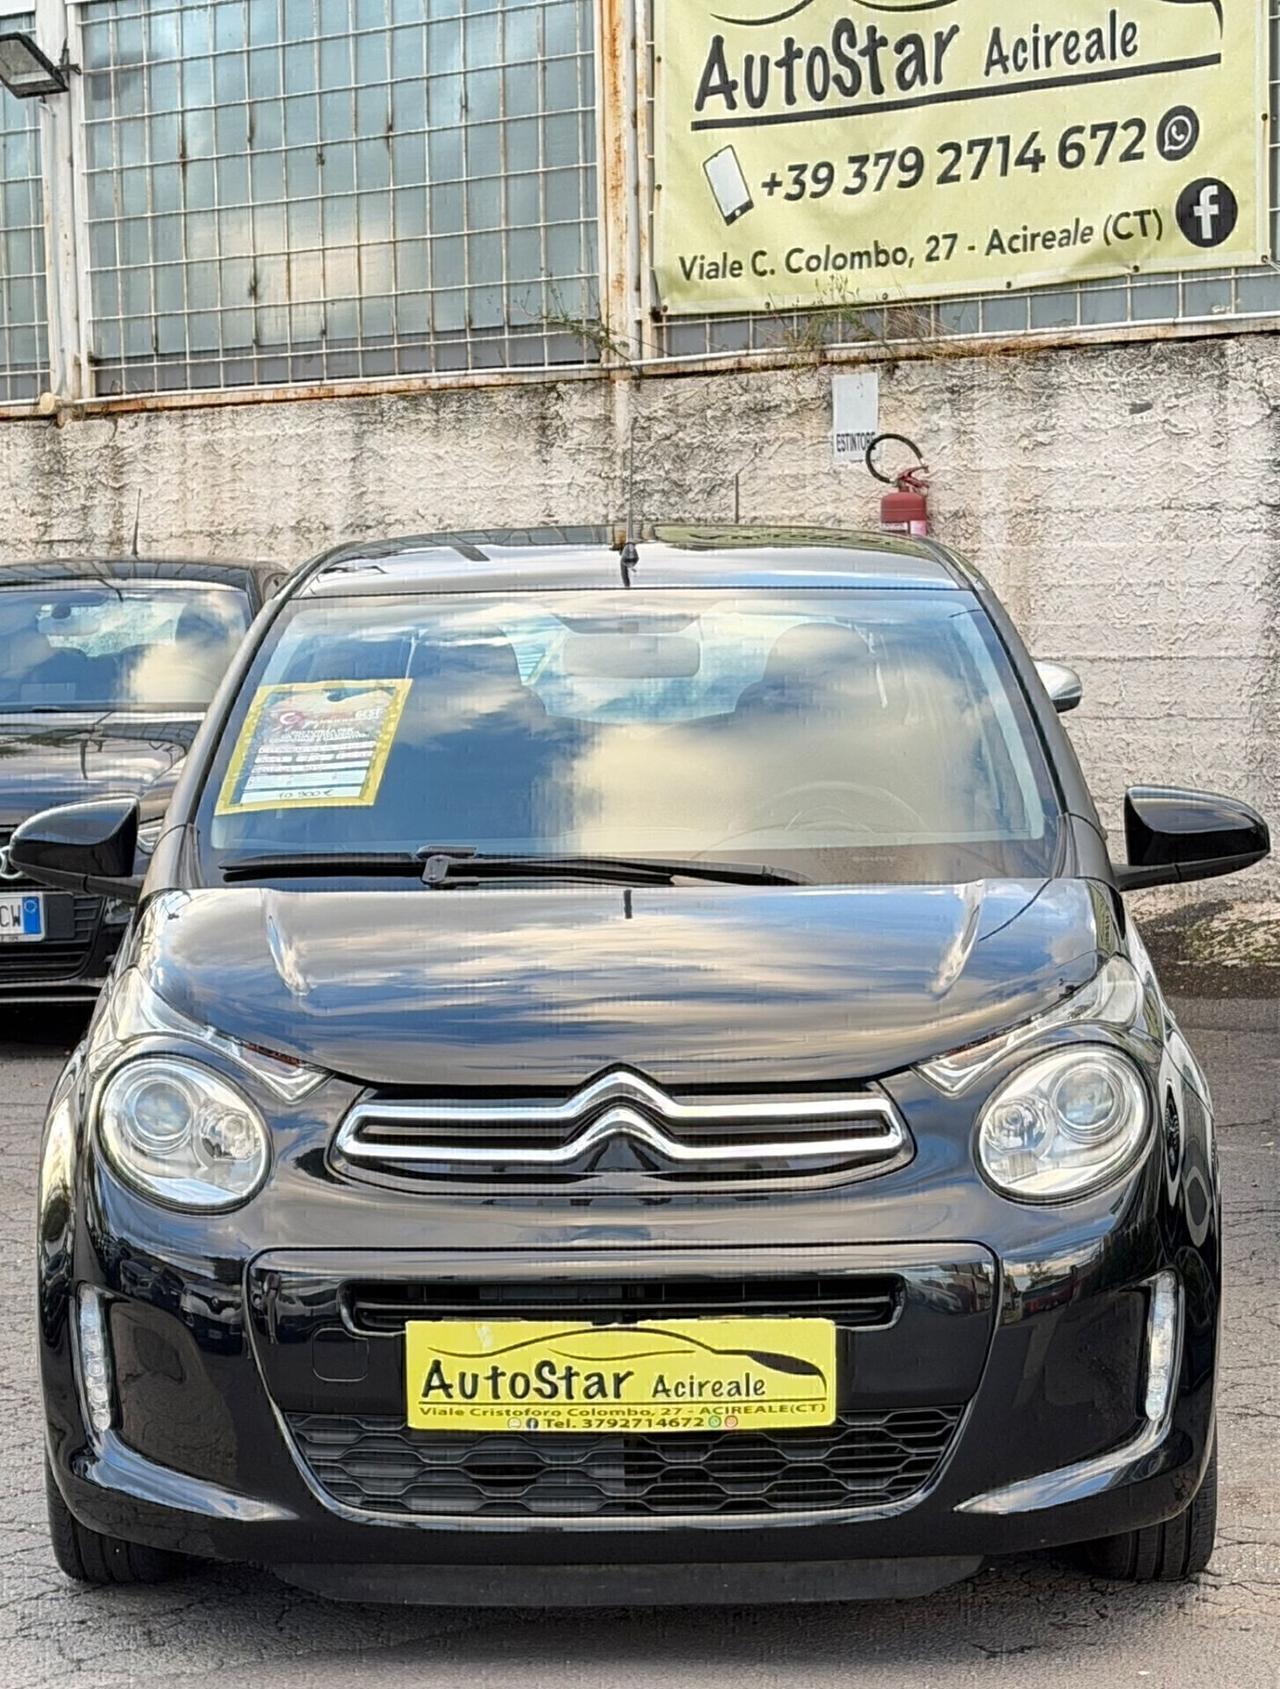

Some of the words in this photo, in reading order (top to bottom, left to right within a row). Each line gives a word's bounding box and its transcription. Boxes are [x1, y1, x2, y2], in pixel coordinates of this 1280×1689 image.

[695, 18, 960, 111] AutoStar
[984, 9, 1138, 76] Acireale
[761, 161, 834, 201] +39
[843, 146, 924, 195] 379
[936, 131, 1046, 185] 2714
[1057, 117, 1146, 169] 672
[679, 252, 743, 281] Viale
[751, 250, 776, 277] C.
[785, 240, 914, 274] Colombo,
[925, 233, 958, 262] 27
[985, 217, 1094, 256] Acireale
[1103, 208, 1163, 246] (CT)
[421, 1359, 634, 1399] AutoStar
[652, 1372, 765, 1398] Acireale
[420, 1407, 464, 1416] Viale
[470, 1407, 562, 1417] Cristoforo
[567, 1407, 656, 1417] Colombo,
[661, 1407, 681, 1415] 27
[700, 1403, 826, 1415] ACIREALE(CT)
[544, 1418, 576, 1428] Tel.
[582, 1416, 704, 1428] 3792714672
